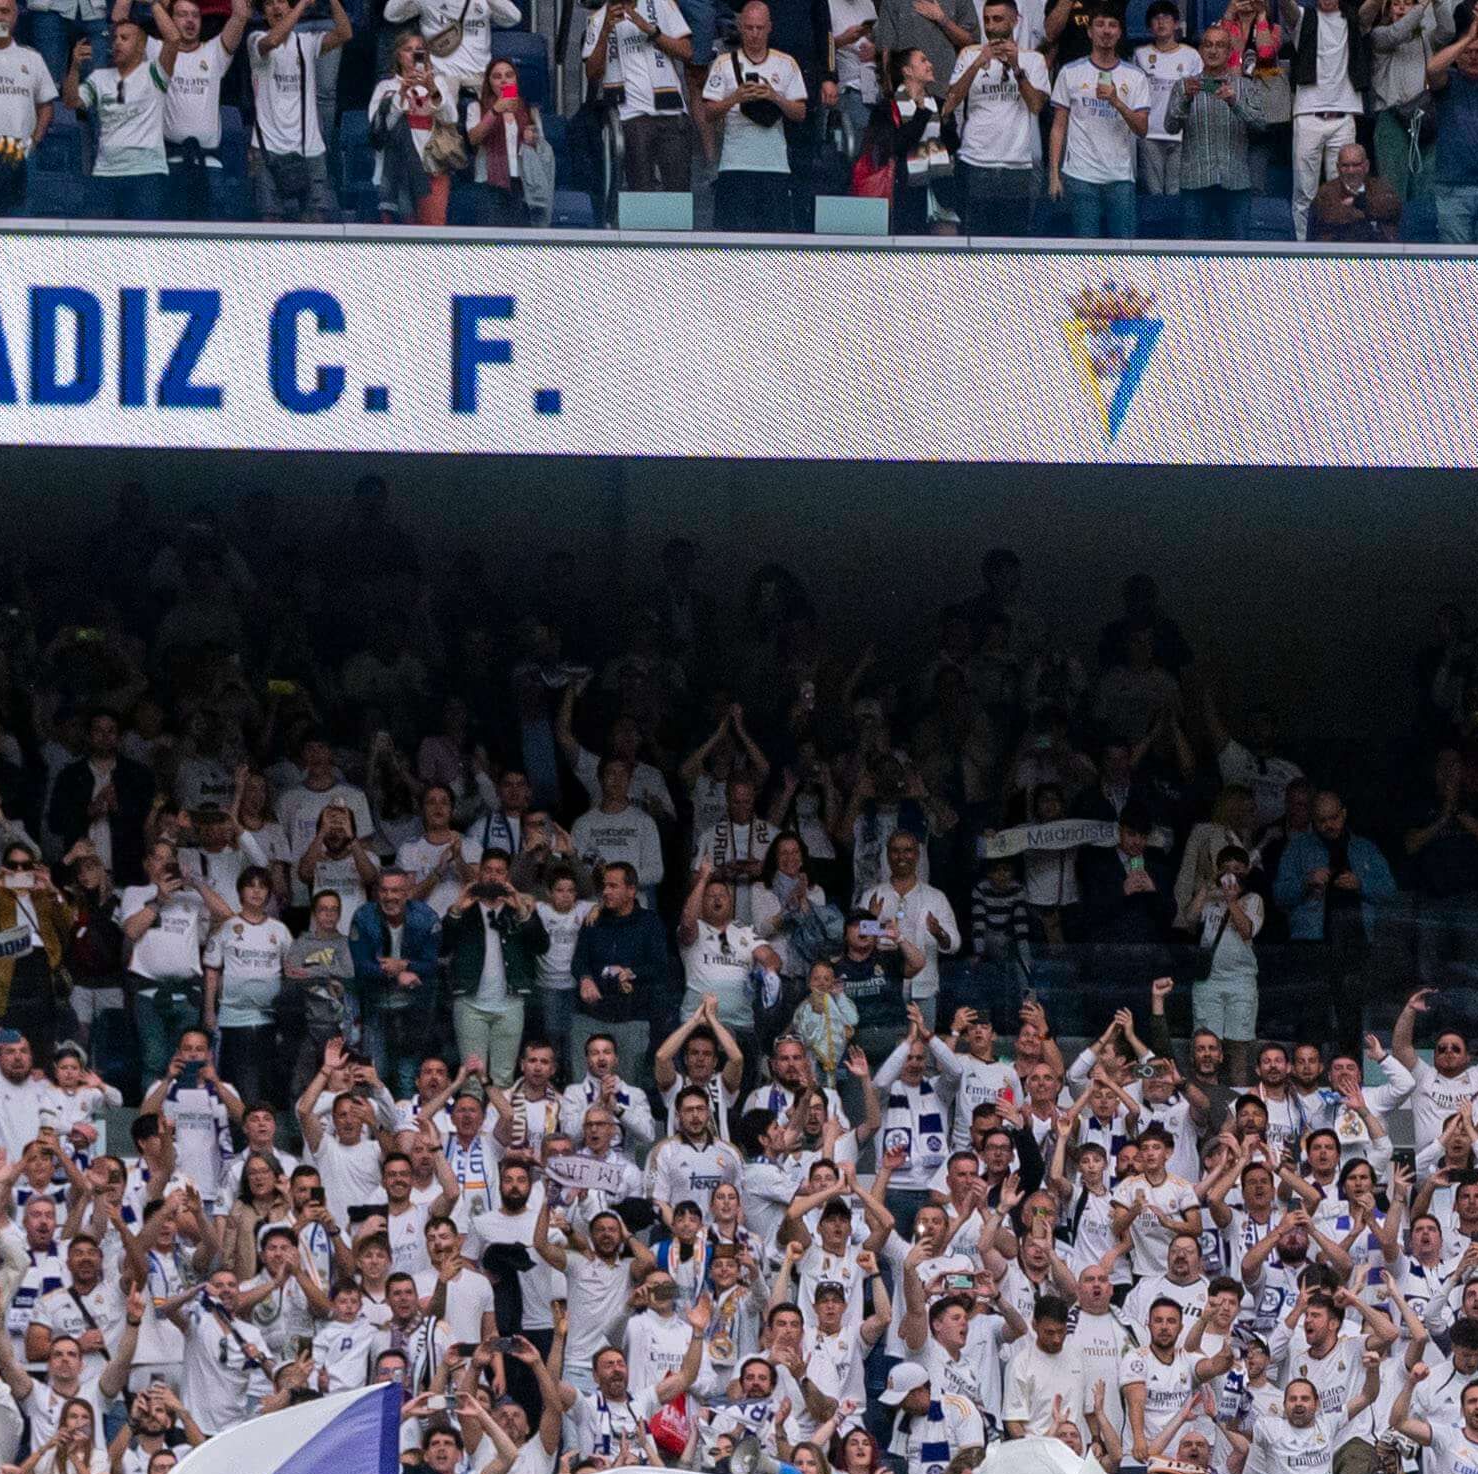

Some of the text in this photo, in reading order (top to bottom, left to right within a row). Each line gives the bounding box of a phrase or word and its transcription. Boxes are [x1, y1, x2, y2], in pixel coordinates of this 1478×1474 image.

[266, 288, 389, 415] C.
[451, 293, 563, 416] F.
[1026, 823, 1115, 848] Madridista
[688, 1171, 722, 1190] teka
[1147, 1388, 1190, 1400] Emirates
[1286, 1453, 1331, 1467] Emirates
